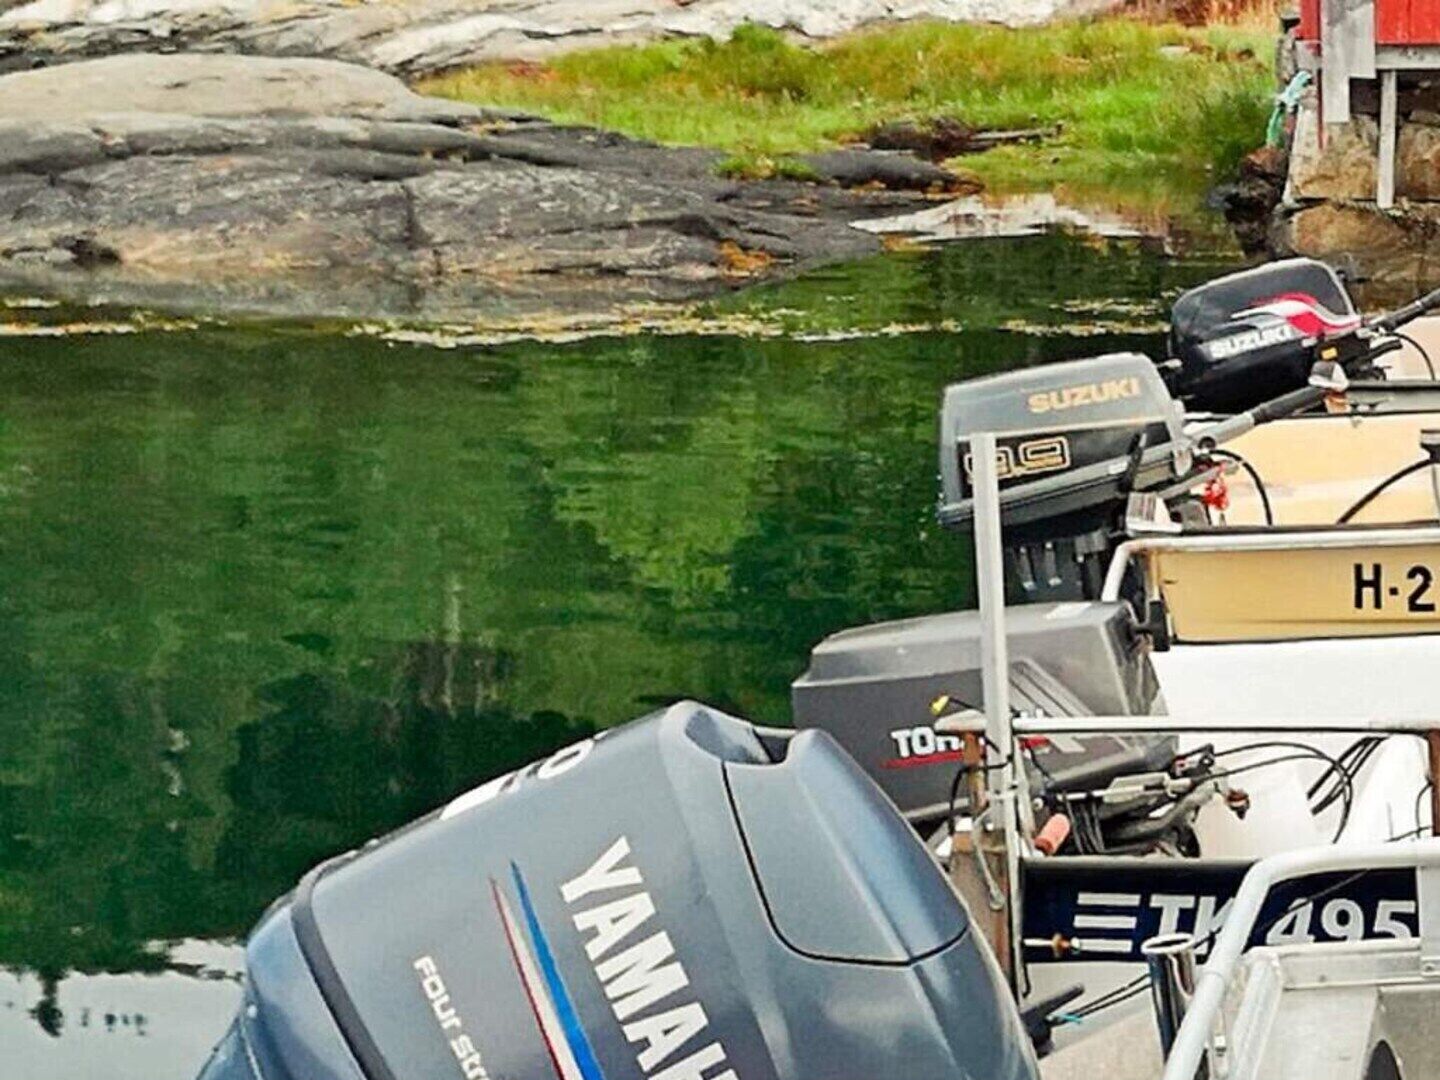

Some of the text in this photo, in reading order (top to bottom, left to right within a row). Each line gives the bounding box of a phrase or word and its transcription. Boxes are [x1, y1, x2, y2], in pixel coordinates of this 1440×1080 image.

[1208, 323, 1293, 360] SUZUKI
[1028, 376, 1141, 414] SUZUKI
[1266, 898, 1416, 946] 495
